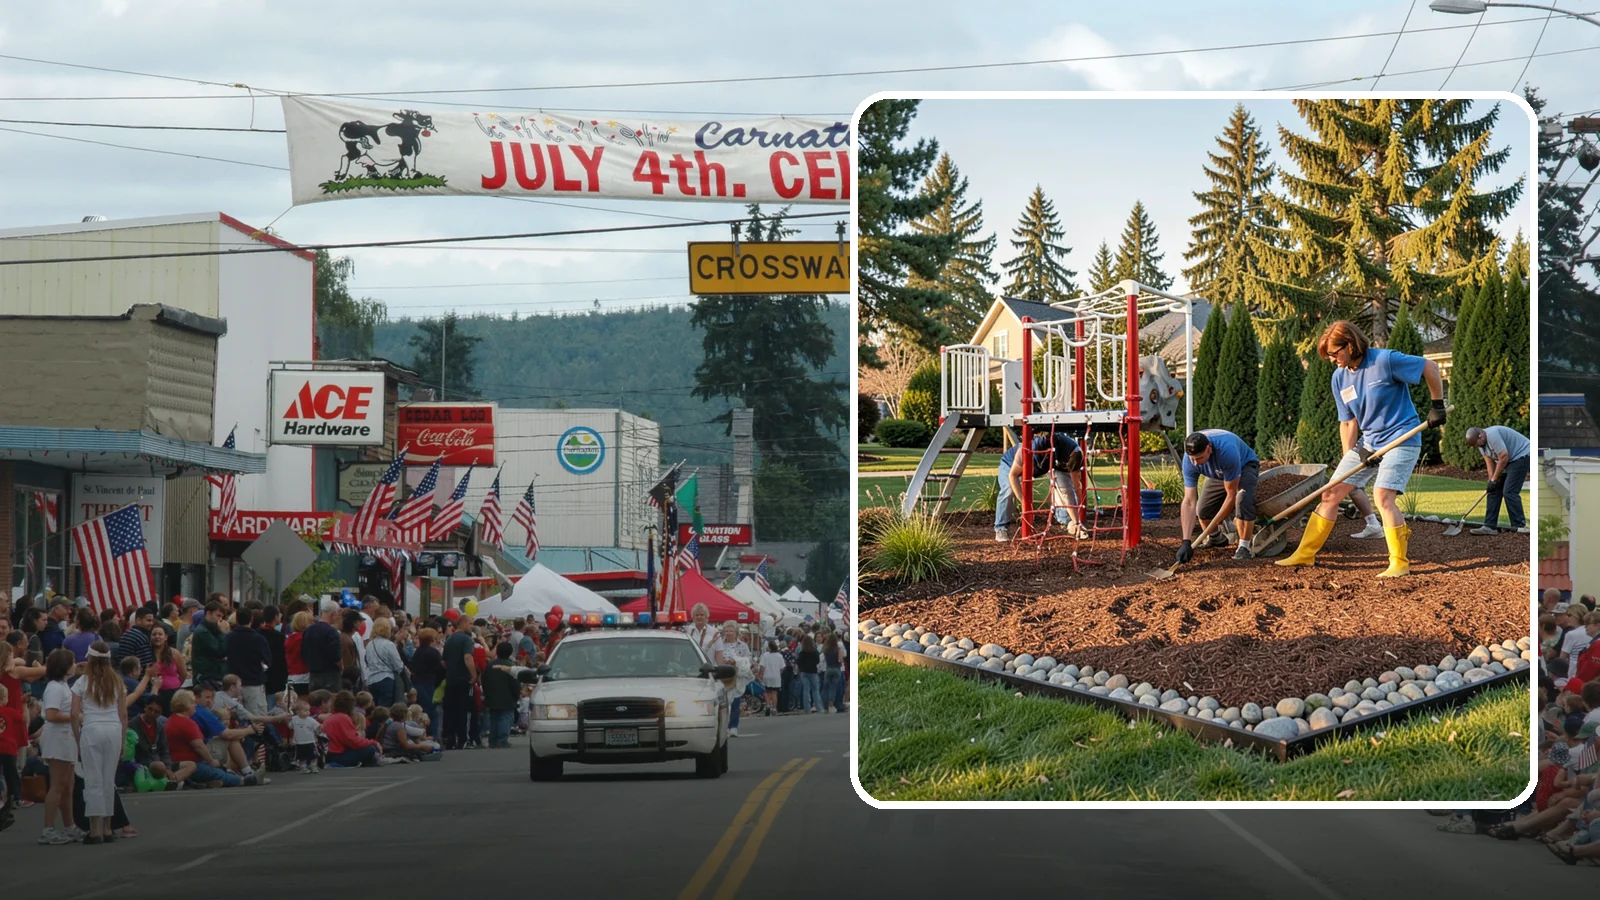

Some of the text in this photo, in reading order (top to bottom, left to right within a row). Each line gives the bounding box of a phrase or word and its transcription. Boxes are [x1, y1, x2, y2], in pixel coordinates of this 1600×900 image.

[481, 141, 605, 192] JULY
[632, 149, 746, 198] 4th.
[697, 254, 850, 280] CROSSWA
[282, 380, 374, 420] ACE
[405, 409, 452, 422] CEDAR
[283, 421, 370, 437] Hardware
[416, 428, 477, 447] Coca-Cola
[353, 467, 386, 479] Simpl
[96, 485, 124, 494] Vincent
[126, 486, 136, 494] de
[137, 486, 155, 495] Paul
[688, 526, 741, 535] CRNATION
[699, 535, 730, 543] GLASS
